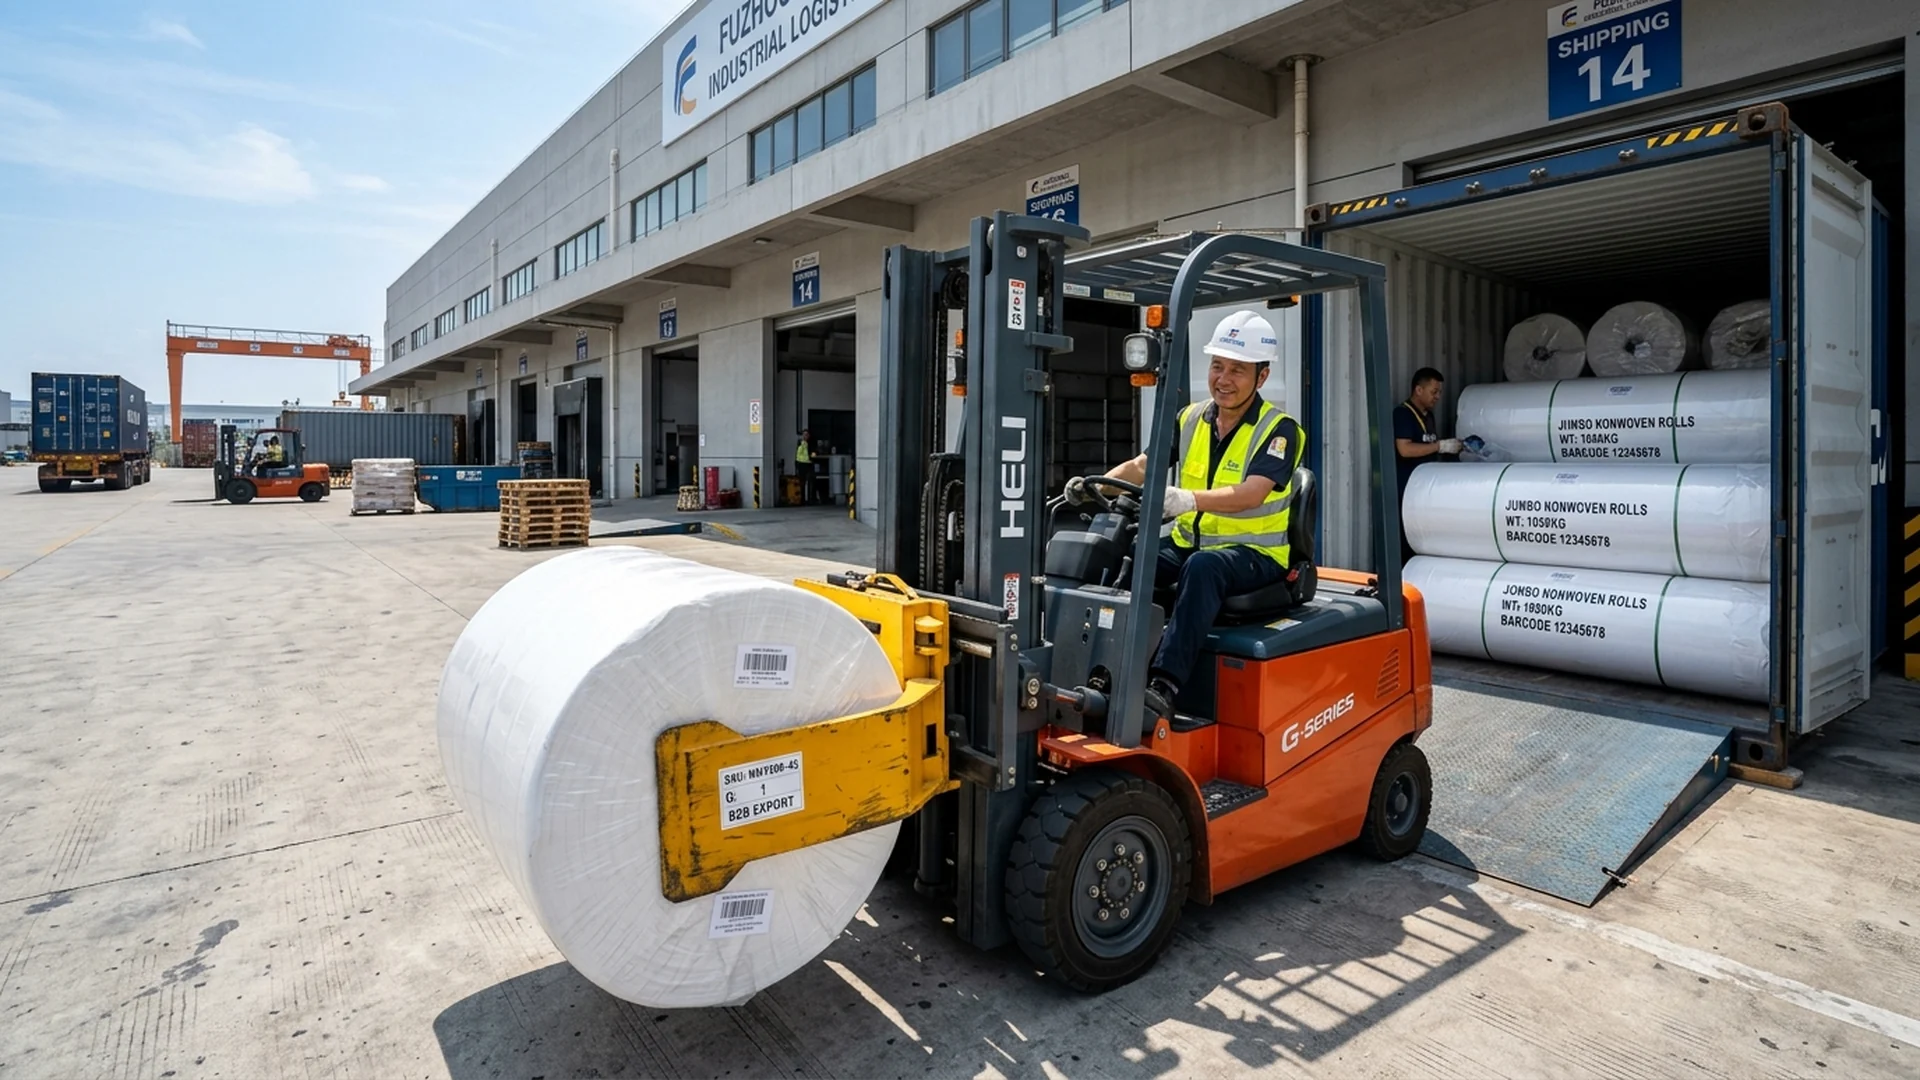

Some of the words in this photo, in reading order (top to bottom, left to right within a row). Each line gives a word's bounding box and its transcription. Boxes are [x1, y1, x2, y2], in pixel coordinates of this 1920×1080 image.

[1558, 11, 1670, 59] SHIPPING
[709, 25, 786, 99] INDUSTRIAL
[1578, 43, 1651, 102] 14
[798, 281, 813, 302] 14
[1658, 416, 1695, 428] ROLLS
[1560, 434, 1578, 444] WT:
[1001, 416, 1026, 538] HELI
[1610, 503, 1648, 516] ROLLS
[1505, 516, 1524, 527] WT:
[1506, 531, 1557, 544] BARCODE
[1559, 534, 1611, 547] 12345678
[1607, 594, 1648, 610] ROLLS
[1501, 614, 1551, 632] BARCODE
[1554, 621, 1606, 639] 12345678
[729, 806, 750, 822] B2B
[753, 795, 795, 816] EXPORT
